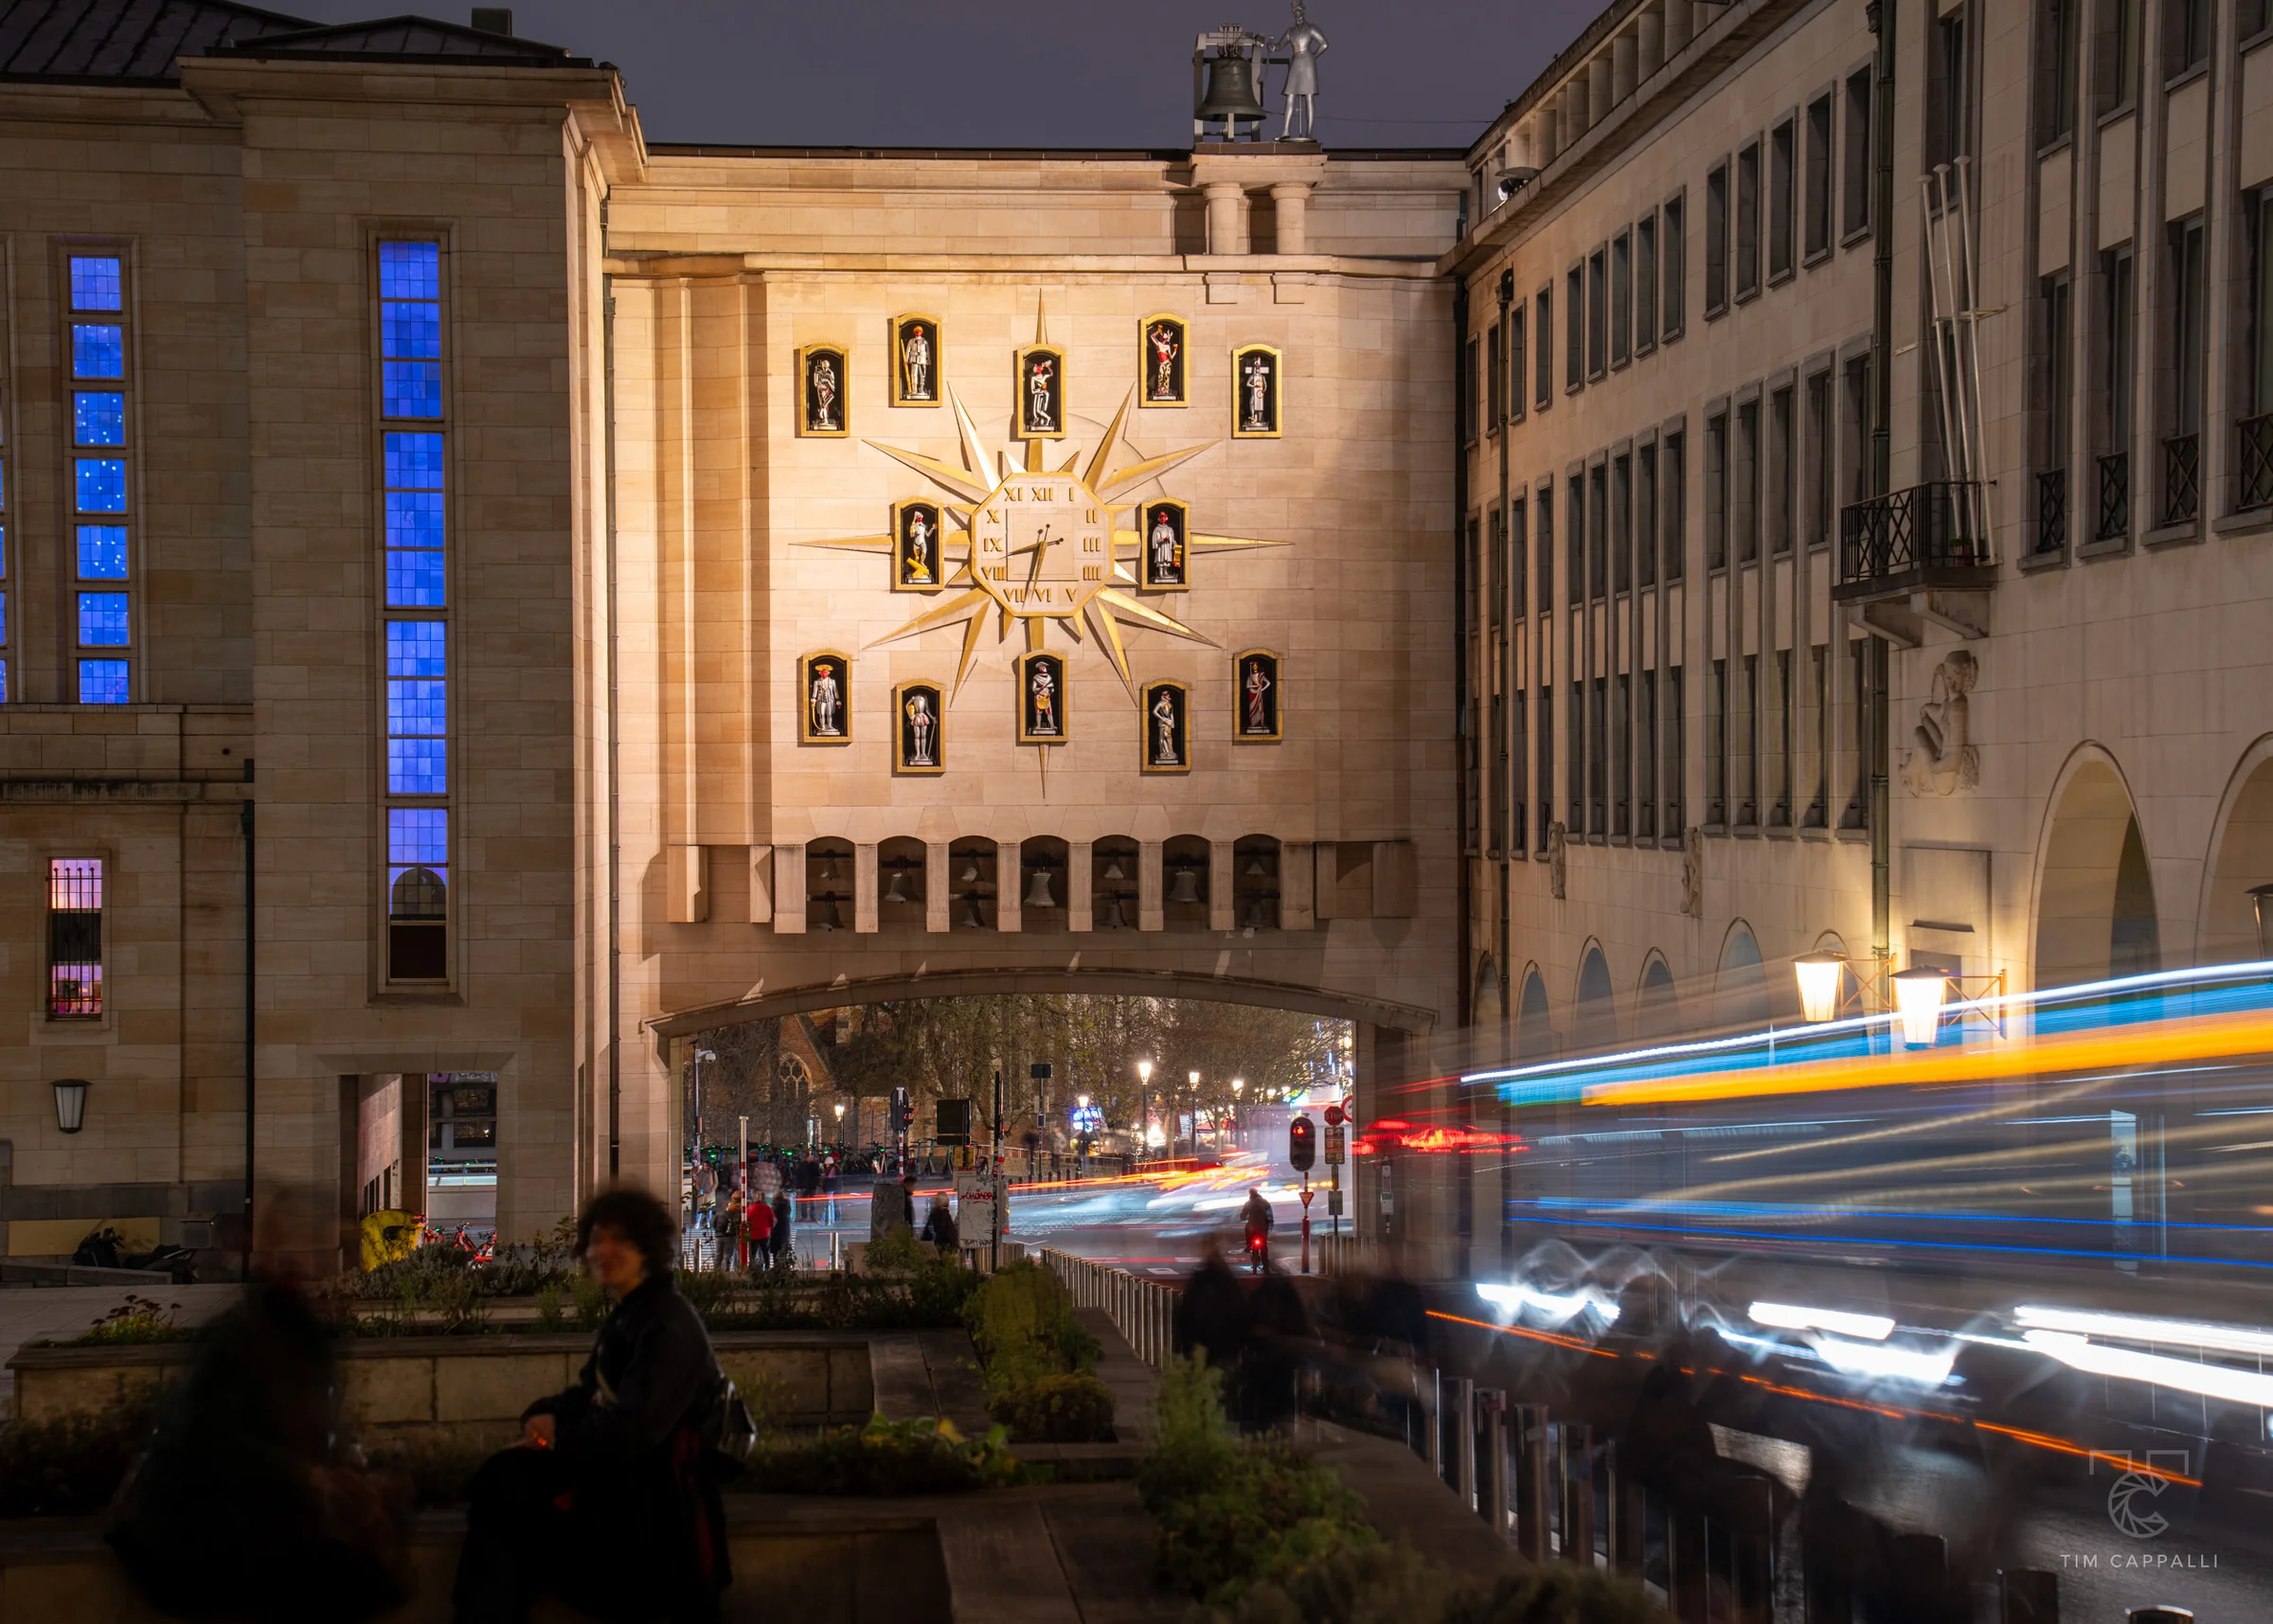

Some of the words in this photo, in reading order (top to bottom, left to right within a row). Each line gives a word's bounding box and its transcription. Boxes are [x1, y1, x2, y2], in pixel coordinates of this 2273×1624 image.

[1004, 487, 1024, 502] XI
[1031, 487, 1053, 502] XII
[1068, 487, 1074, 502] I
[987, 509, 1000, 524] X
[1085, 509, 1098, 524] II
[983, 537, 1004, 552] IX
[1083, 537, 1101, 552] III
[981, 566, 1007, 581] VIII
[1083, 566, 1101, 581] IIII
[1003, 587, 1026, 603] VII
[1034, 587, 1052, 603] VI
[1065, 587, 1078, 602] V
[1325, 1112, 1344, 1120] STOP
